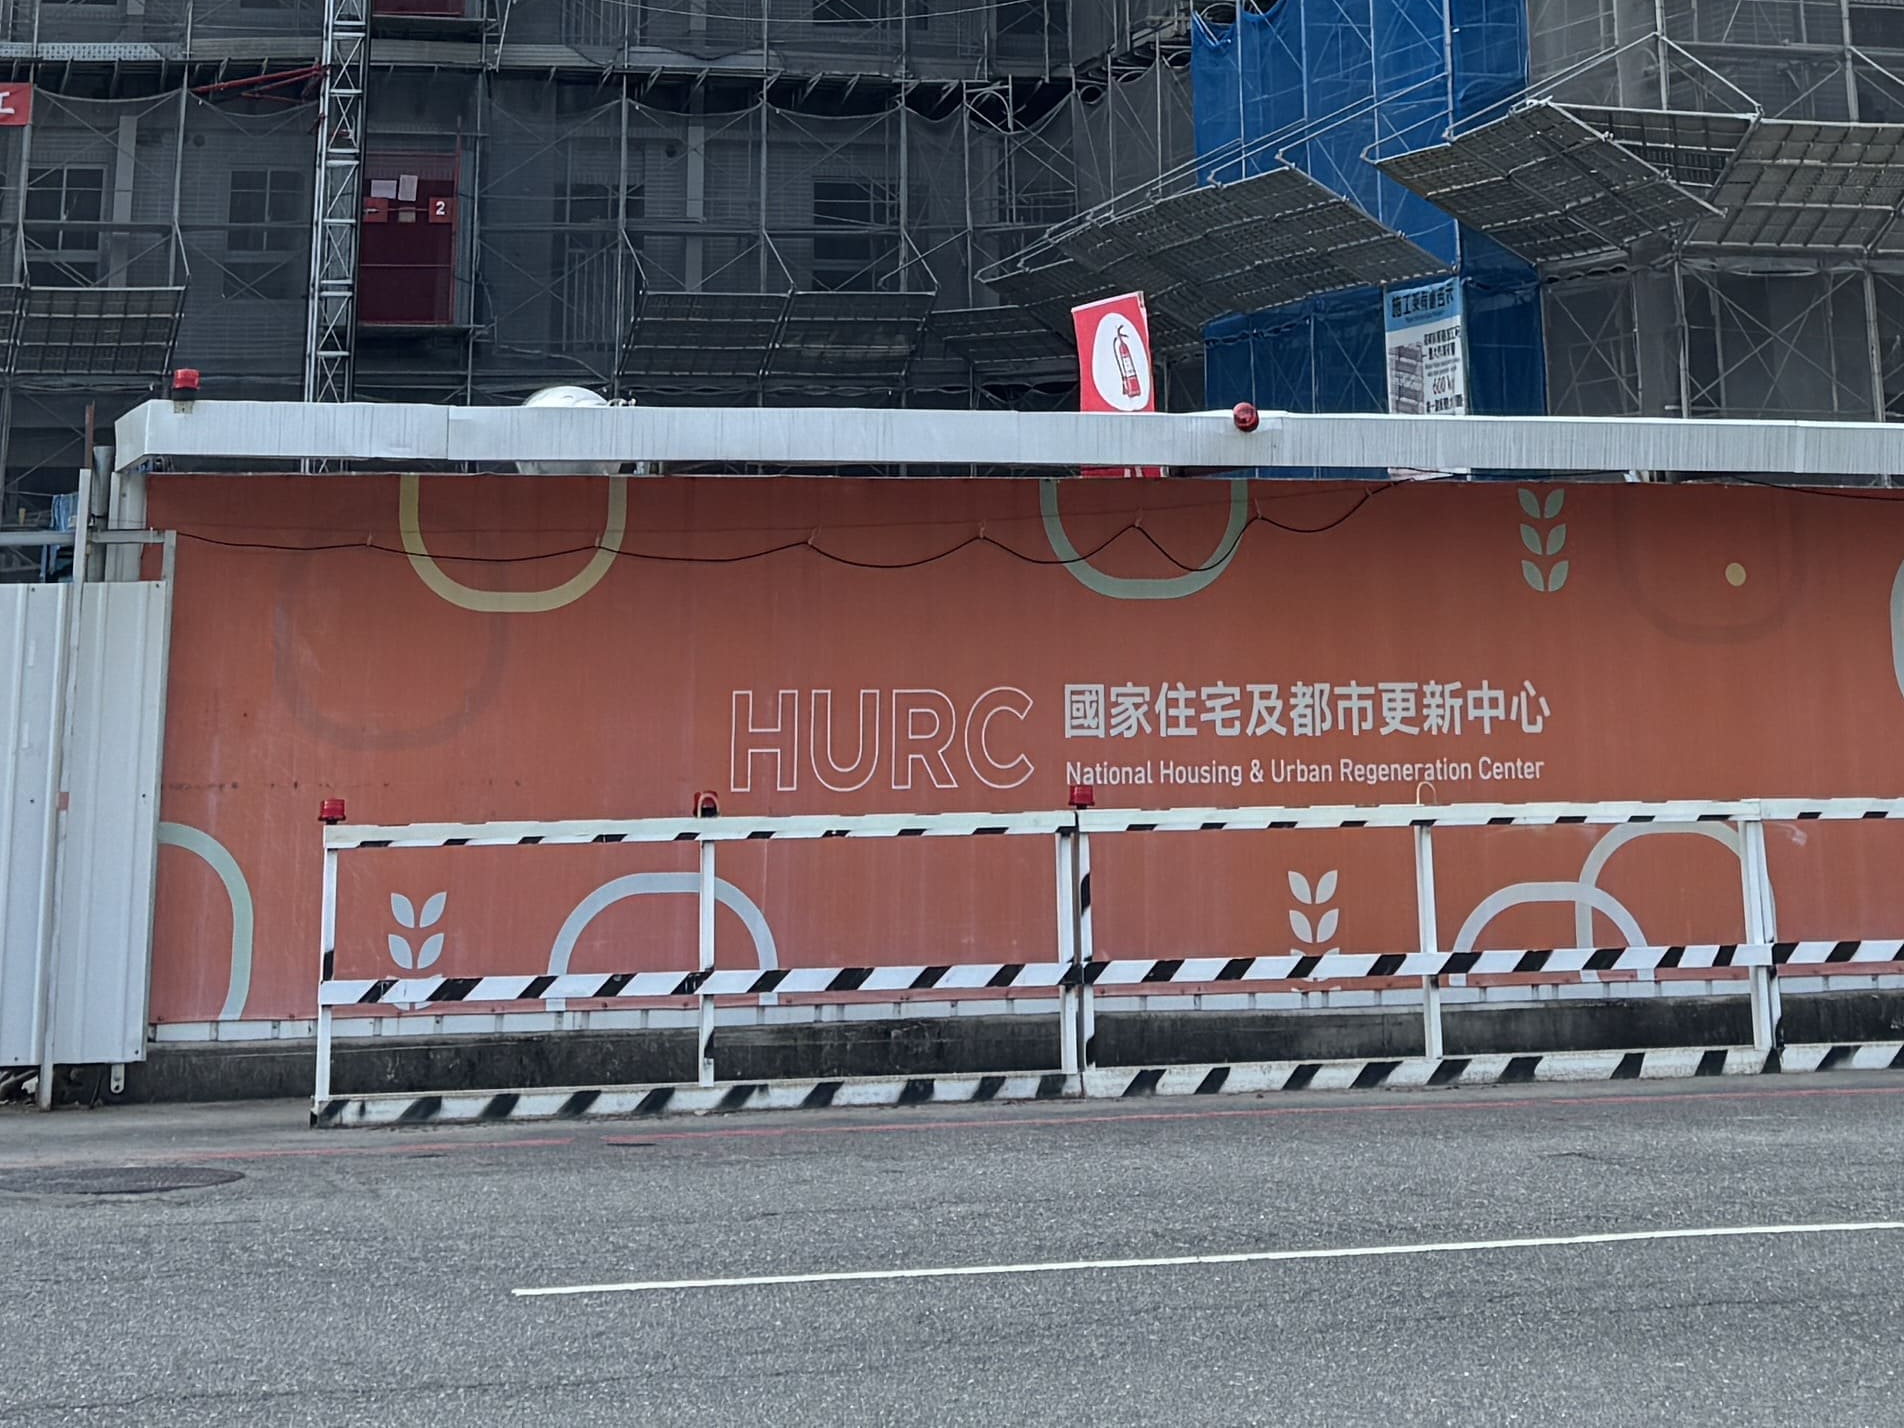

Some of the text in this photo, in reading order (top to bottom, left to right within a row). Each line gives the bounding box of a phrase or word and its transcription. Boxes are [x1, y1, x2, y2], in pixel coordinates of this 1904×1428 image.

[436, 200, 445, 215] 2
[1064, 679, 1551, 739] 國家住宅及都市更新中心
[729, 685, 1035, 793] HURC
[1066, 756, 1544, 787] National Housing & Urban Regeneration Center
